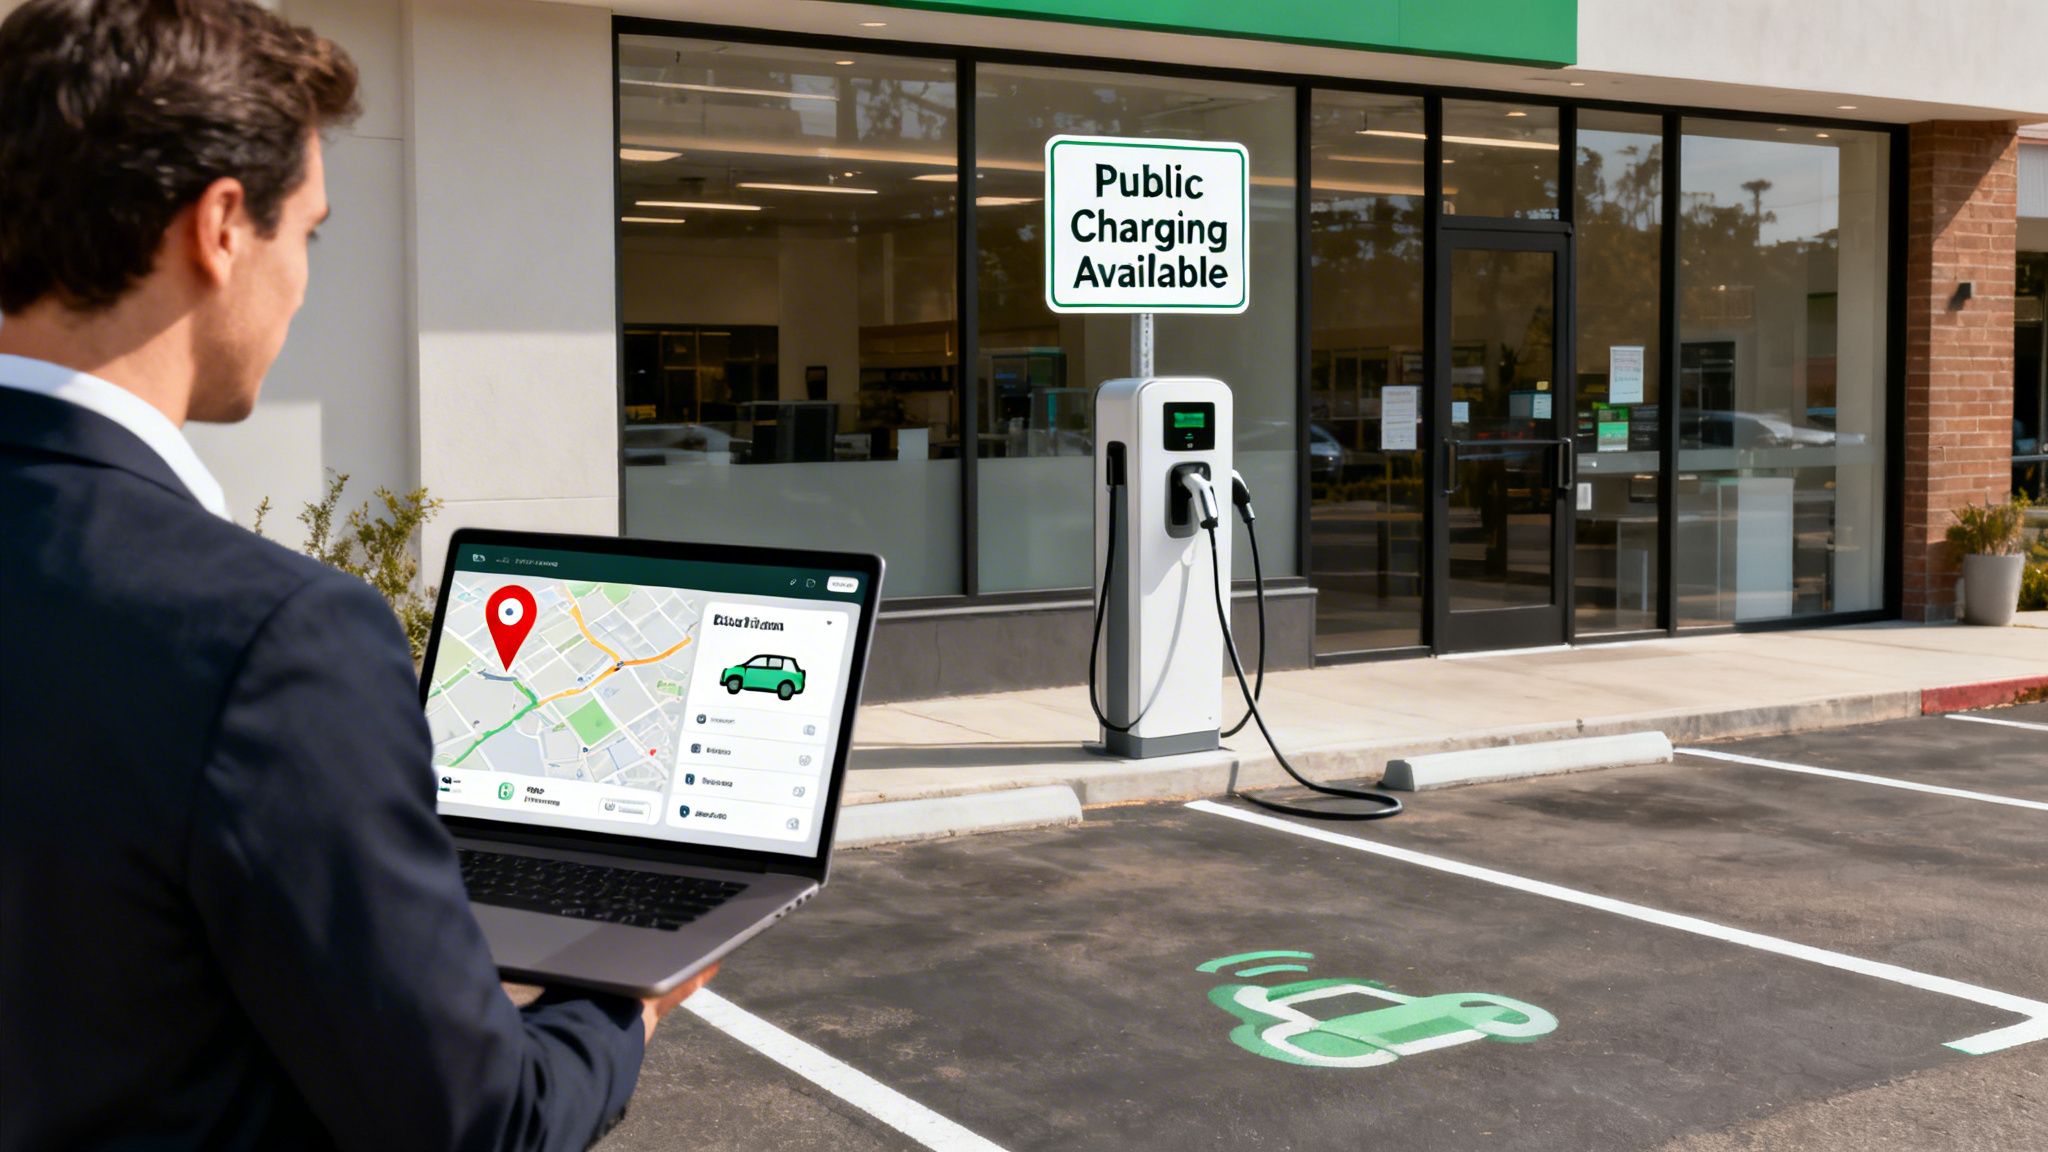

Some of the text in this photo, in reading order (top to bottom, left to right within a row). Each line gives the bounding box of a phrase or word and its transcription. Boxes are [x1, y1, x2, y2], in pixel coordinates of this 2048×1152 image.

[1096, 163, 1204, 199] Public
[1071, 209, 1227, 253] Charging
[1073, 253, 1228, 288] Available
